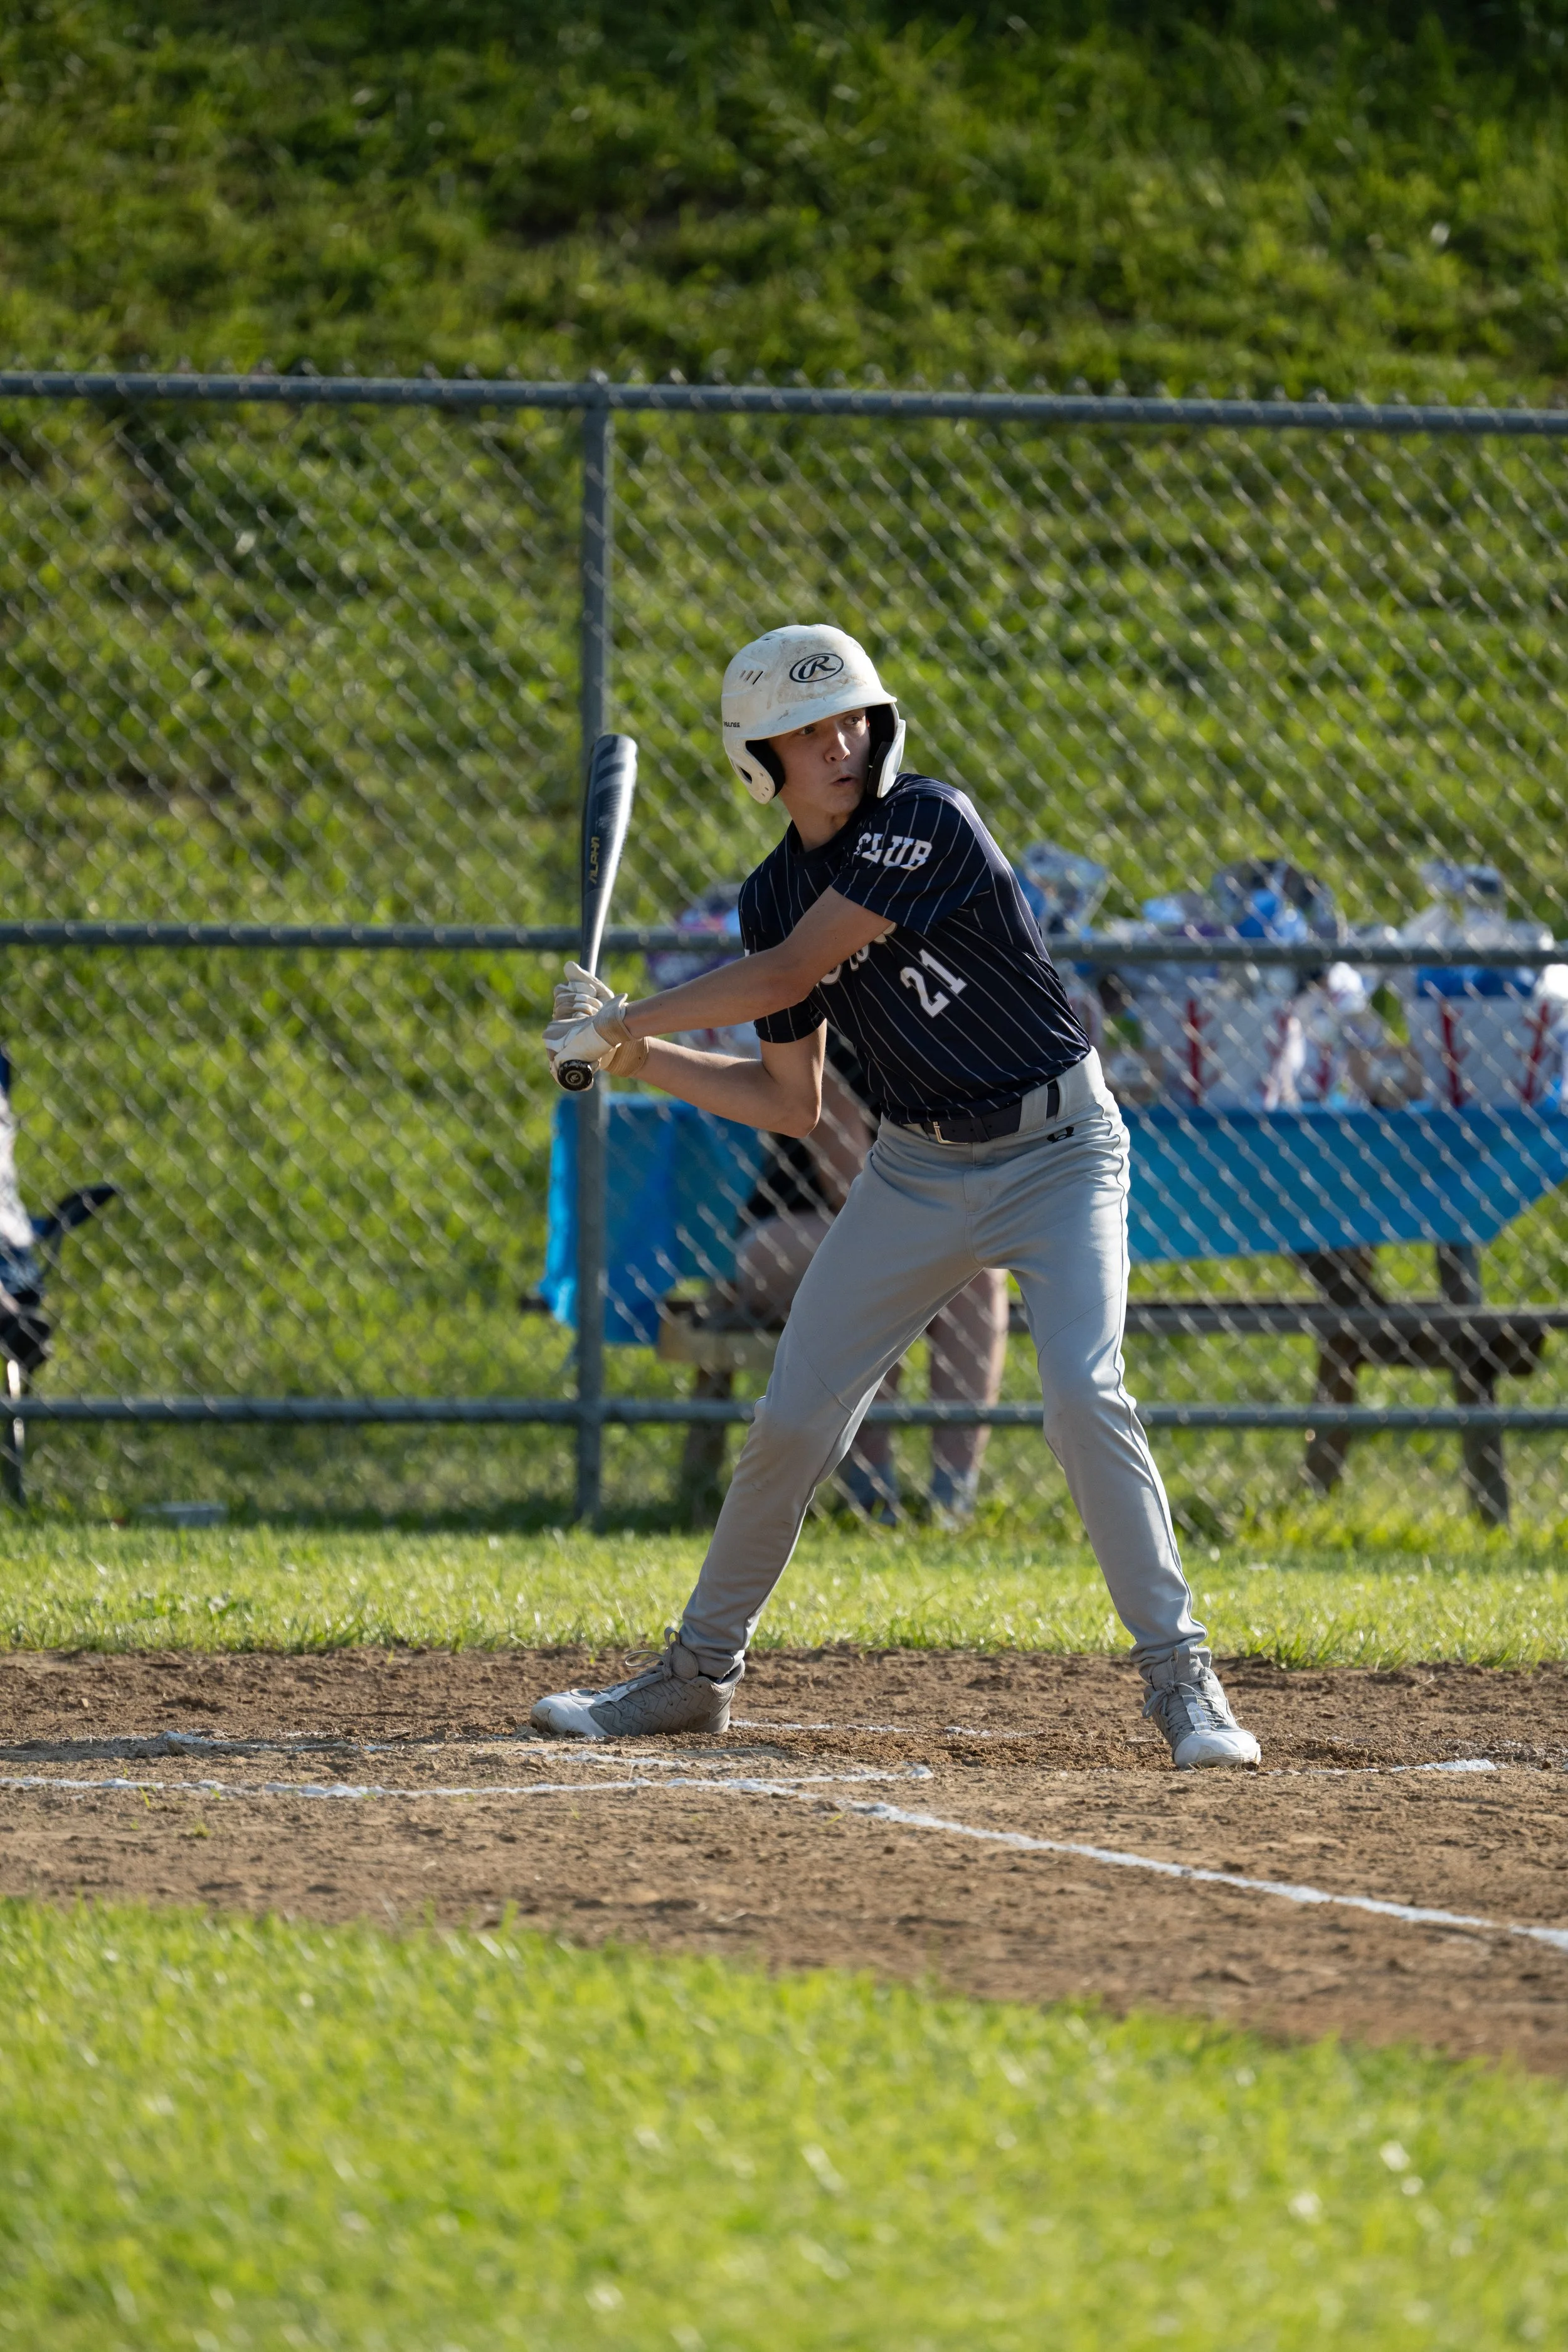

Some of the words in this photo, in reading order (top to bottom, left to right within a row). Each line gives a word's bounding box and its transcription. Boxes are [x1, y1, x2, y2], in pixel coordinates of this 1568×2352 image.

[590, 836, 600, 884] ALPHA
[853, 832, 933, 871] CLUB
[900, 948, 967, 1018] 21
